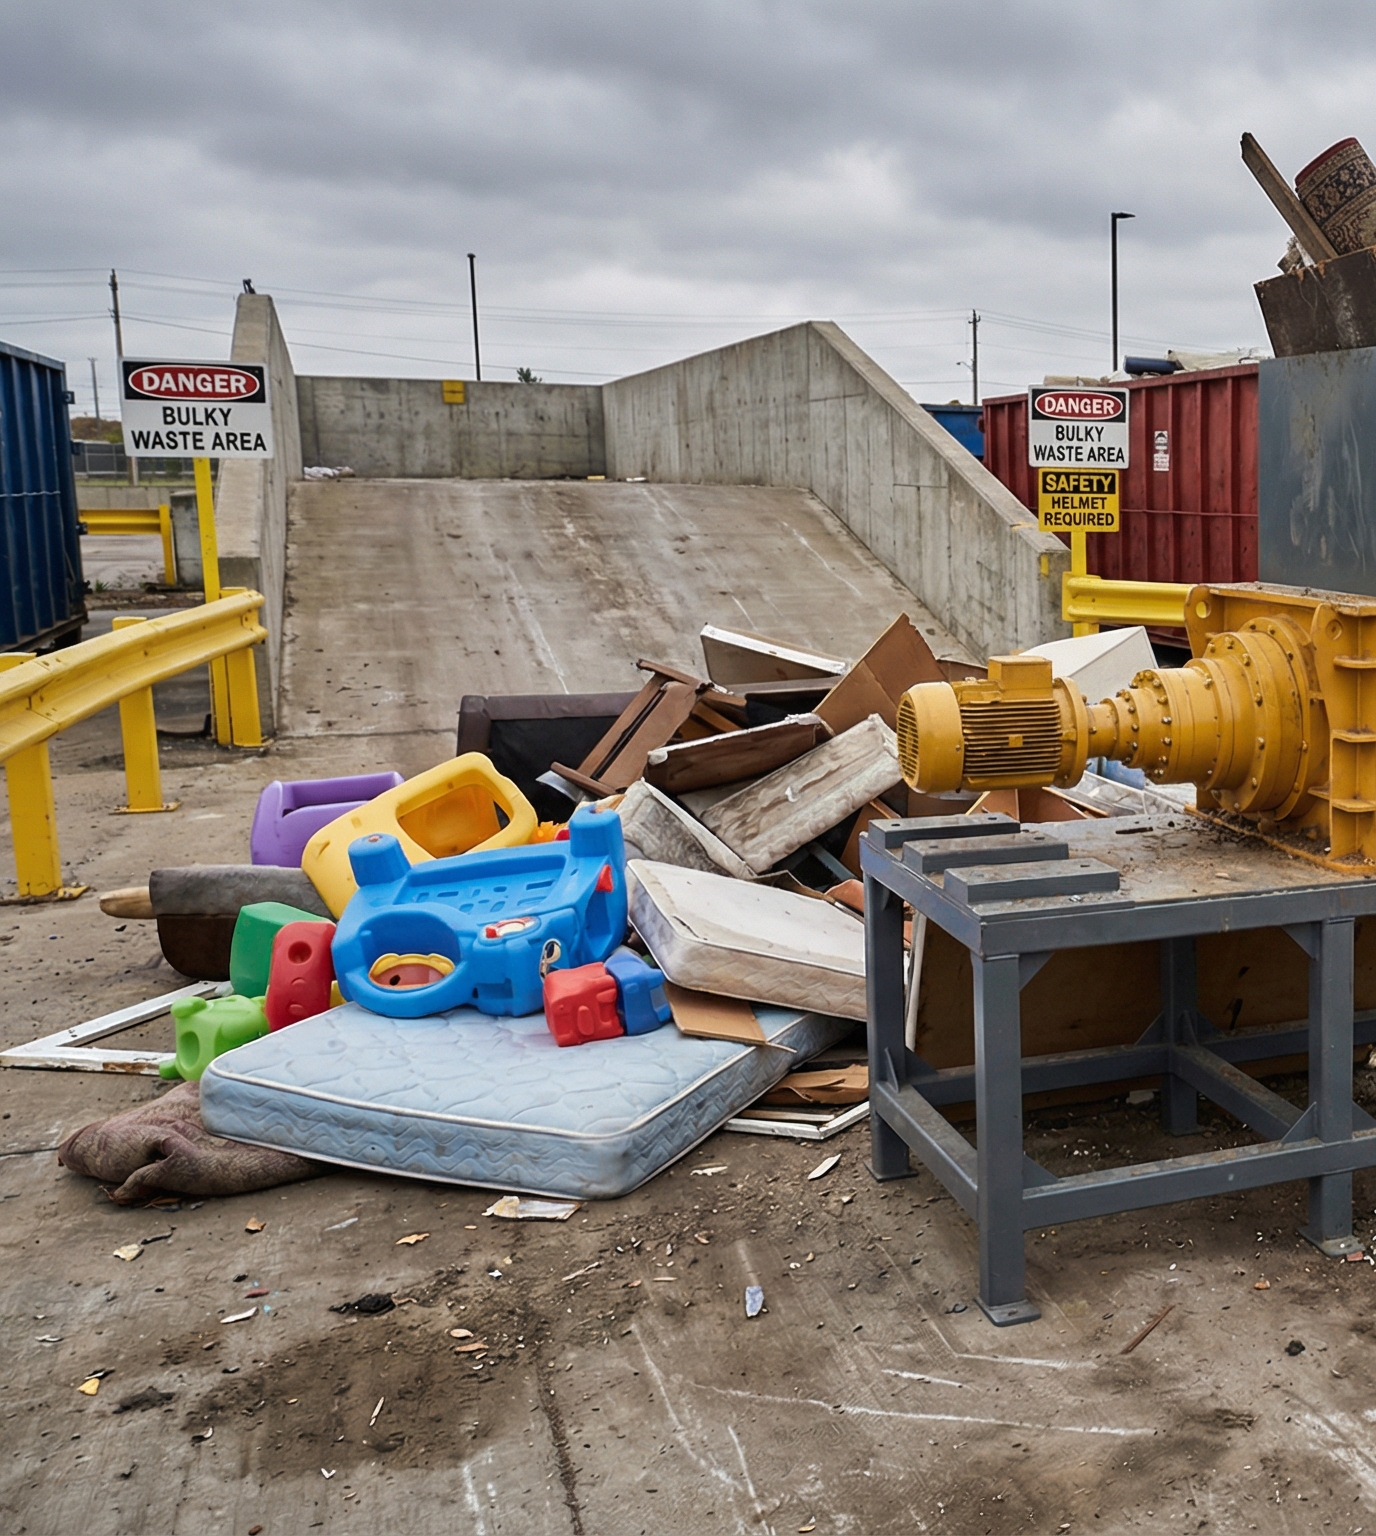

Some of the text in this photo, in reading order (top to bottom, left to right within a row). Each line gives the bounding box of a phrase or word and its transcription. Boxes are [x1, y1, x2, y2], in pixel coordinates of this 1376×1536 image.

[142, 372, 247, 393] DANGER
[1044, 396, 1115, 415] DANGER
[162, 406, 232, 426] BULKY
[131, 430, 267, 452] WASTE AREA
[1055, 425, 1104, 442] BULKY
[1034, 445, 1125, 463] WASTE AREA
[1045, 474, 1113, 492] SAFETY
[1051, 496, 1107, 509] HELMET
[1044, 512, 1115, 526] REQUIRED
